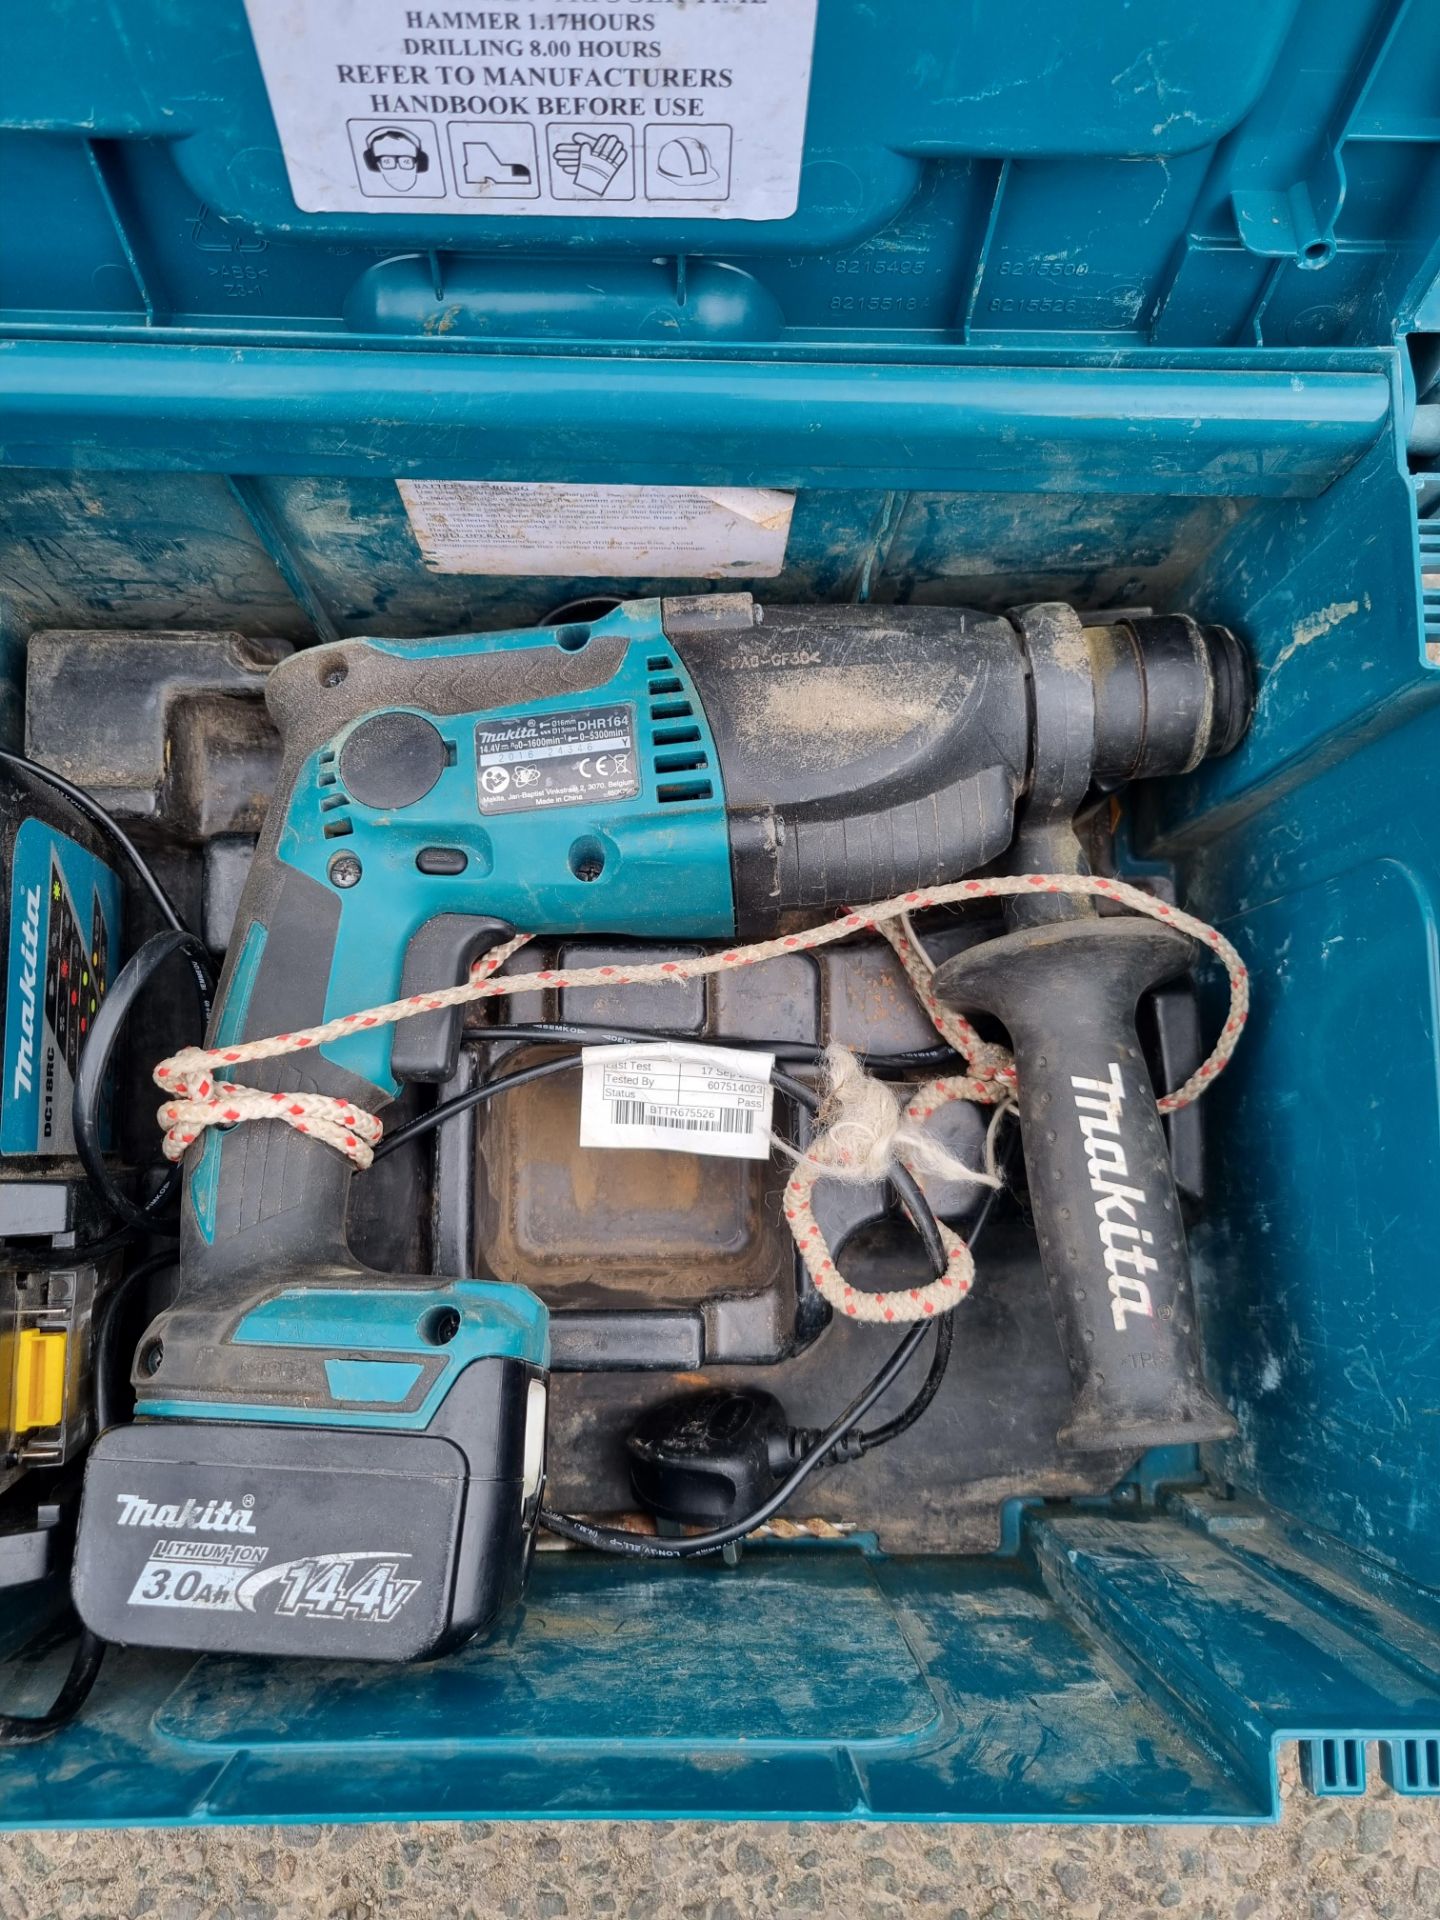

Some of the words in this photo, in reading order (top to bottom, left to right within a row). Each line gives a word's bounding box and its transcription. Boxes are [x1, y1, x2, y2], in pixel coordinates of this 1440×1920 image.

[406, 12, 522, 30] HAMMER
[528, 13, 656, 31] 1.17HOURS
[404, 39, 523, 57] DRILLING
[530, 40, 571, 58] 8.00
[578, 40, 662, 58] HOURS
[338, 65, 431, 85] REFER
[439, 66, 474, 86] TO
[482, 67, 734, 89] MANUFACTURERS
[371, 94, 530, 116] HANDBOOK
[537, 96, 646, 117] BEFORE
[653, 98, 704, 118] USE
[577, 715, 629, 732] DHR164
[480, 743, 500, 753] 14.4V
[621, 736, 630, 747] Y
[608, 779, 635, 788] Belgium
[630, 1061, 652, 1071] Test
[701, 1066, 713, 1075] 17
[605, 1074, 639, 1085] Tested
[642, 1076, 655, 1088] By
[707, 1081, 763, 1095] 607514023
[43, 1046, 55, 1138] DC18RC
[605, 1088, 636, 1099] Status
[737, 1097, 762, 1108] Pass
[649, 1106, 716, 1119] BTTR675526
[142, 1568, 232, 1605] 3.0Ah
